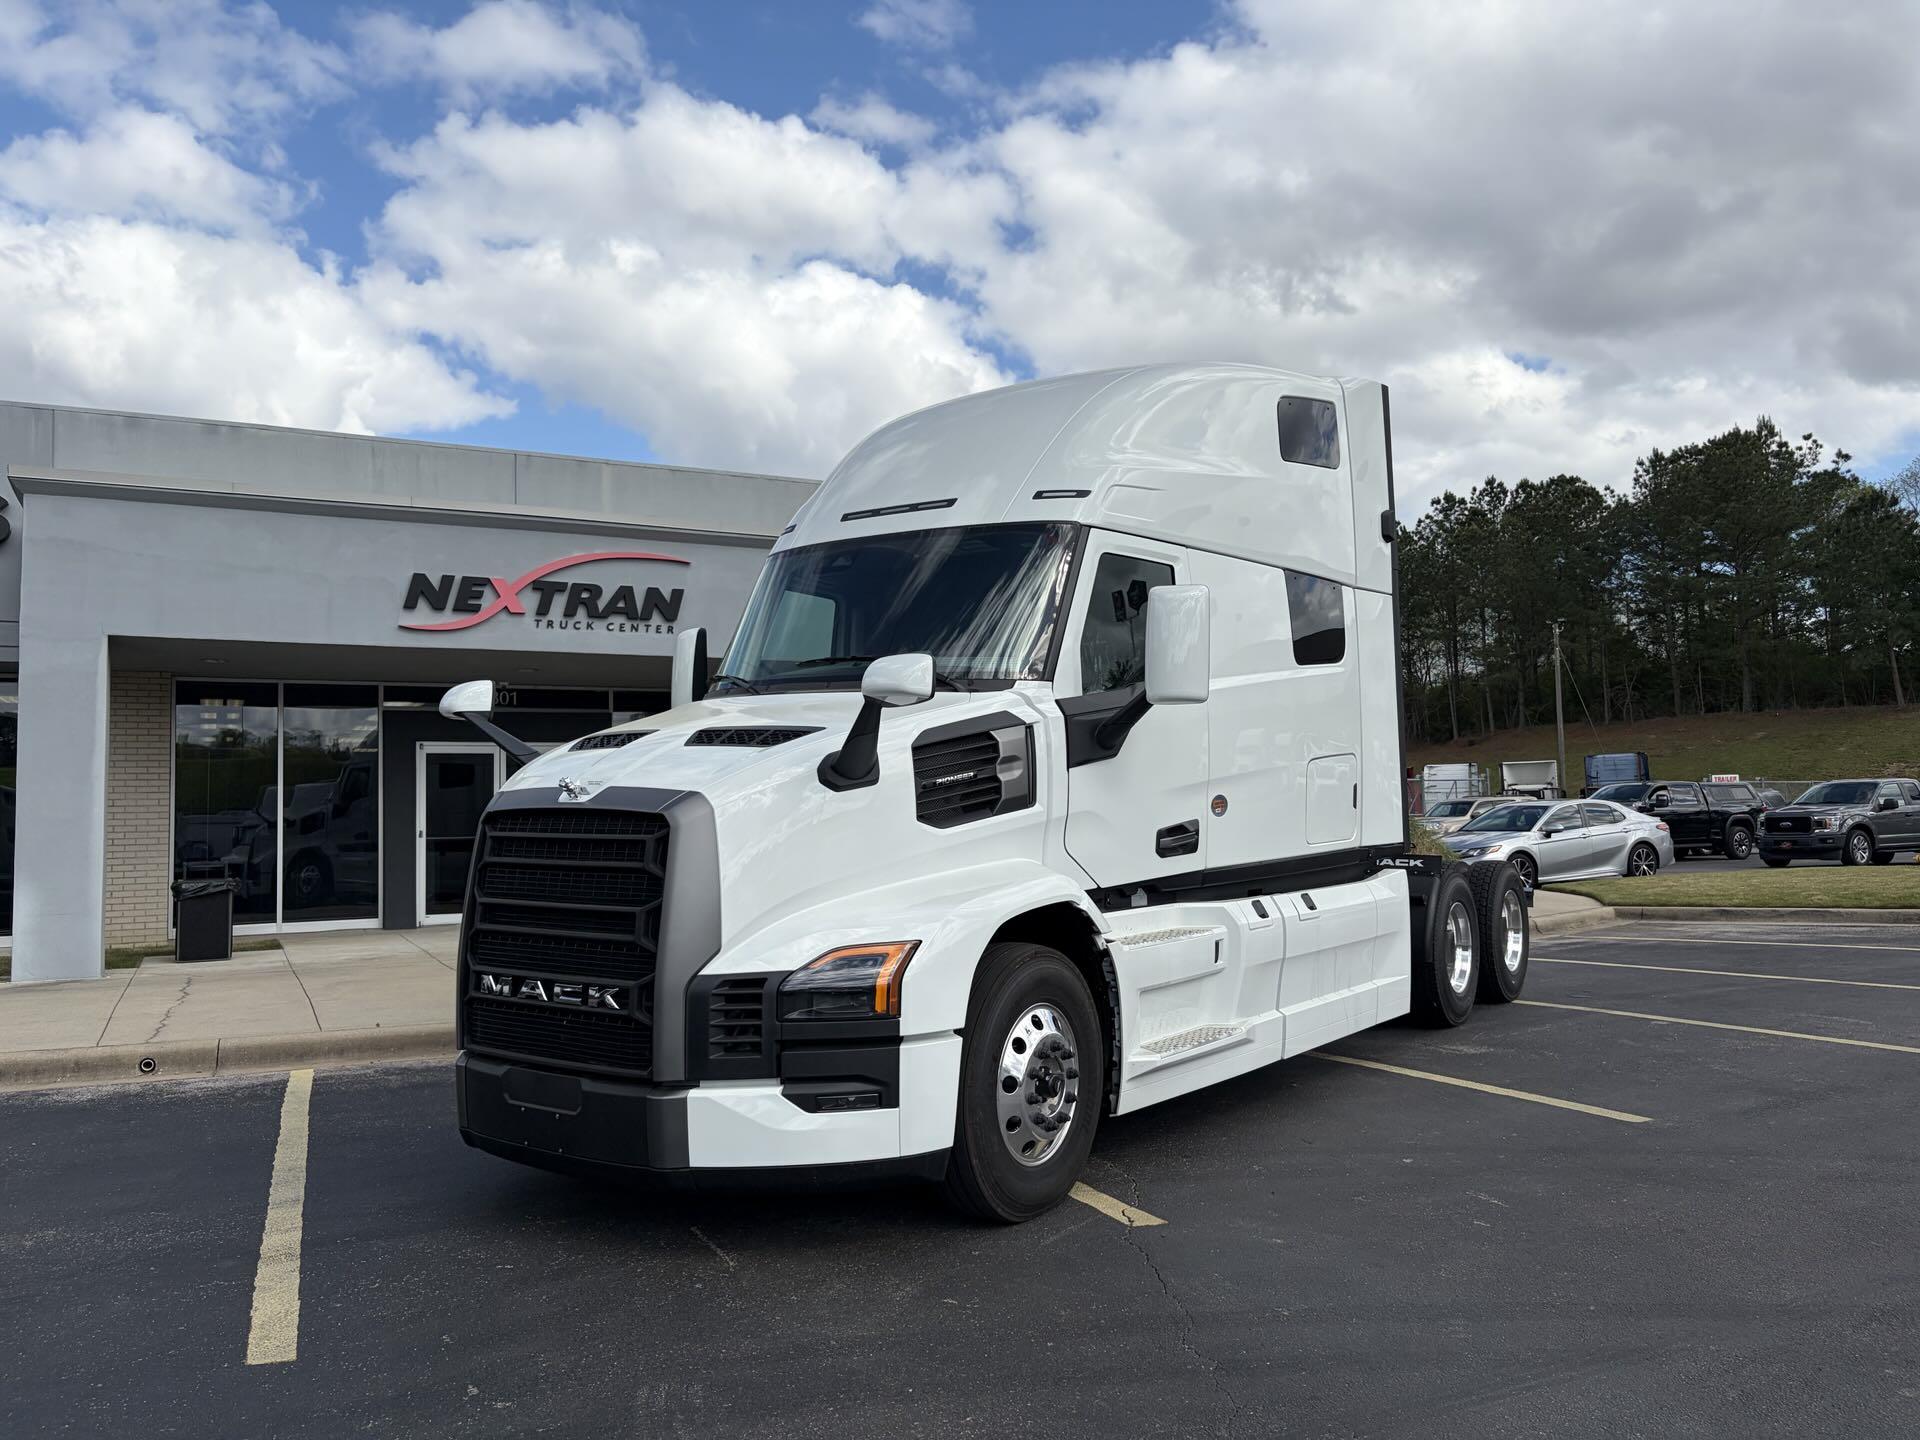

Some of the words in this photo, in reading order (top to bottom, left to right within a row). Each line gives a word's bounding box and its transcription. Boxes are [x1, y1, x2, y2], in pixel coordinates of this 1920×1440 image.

[402, 570, 685, 623] NEXTRAN
[534, 619, 595, 631] TRUCK
[606, 622, 675, 635] CENTER
[935, 771, 975, 786] PIONEER
[1376, 858, 1425, 868] ACK
[480, 974, 621, 1010] MACK
